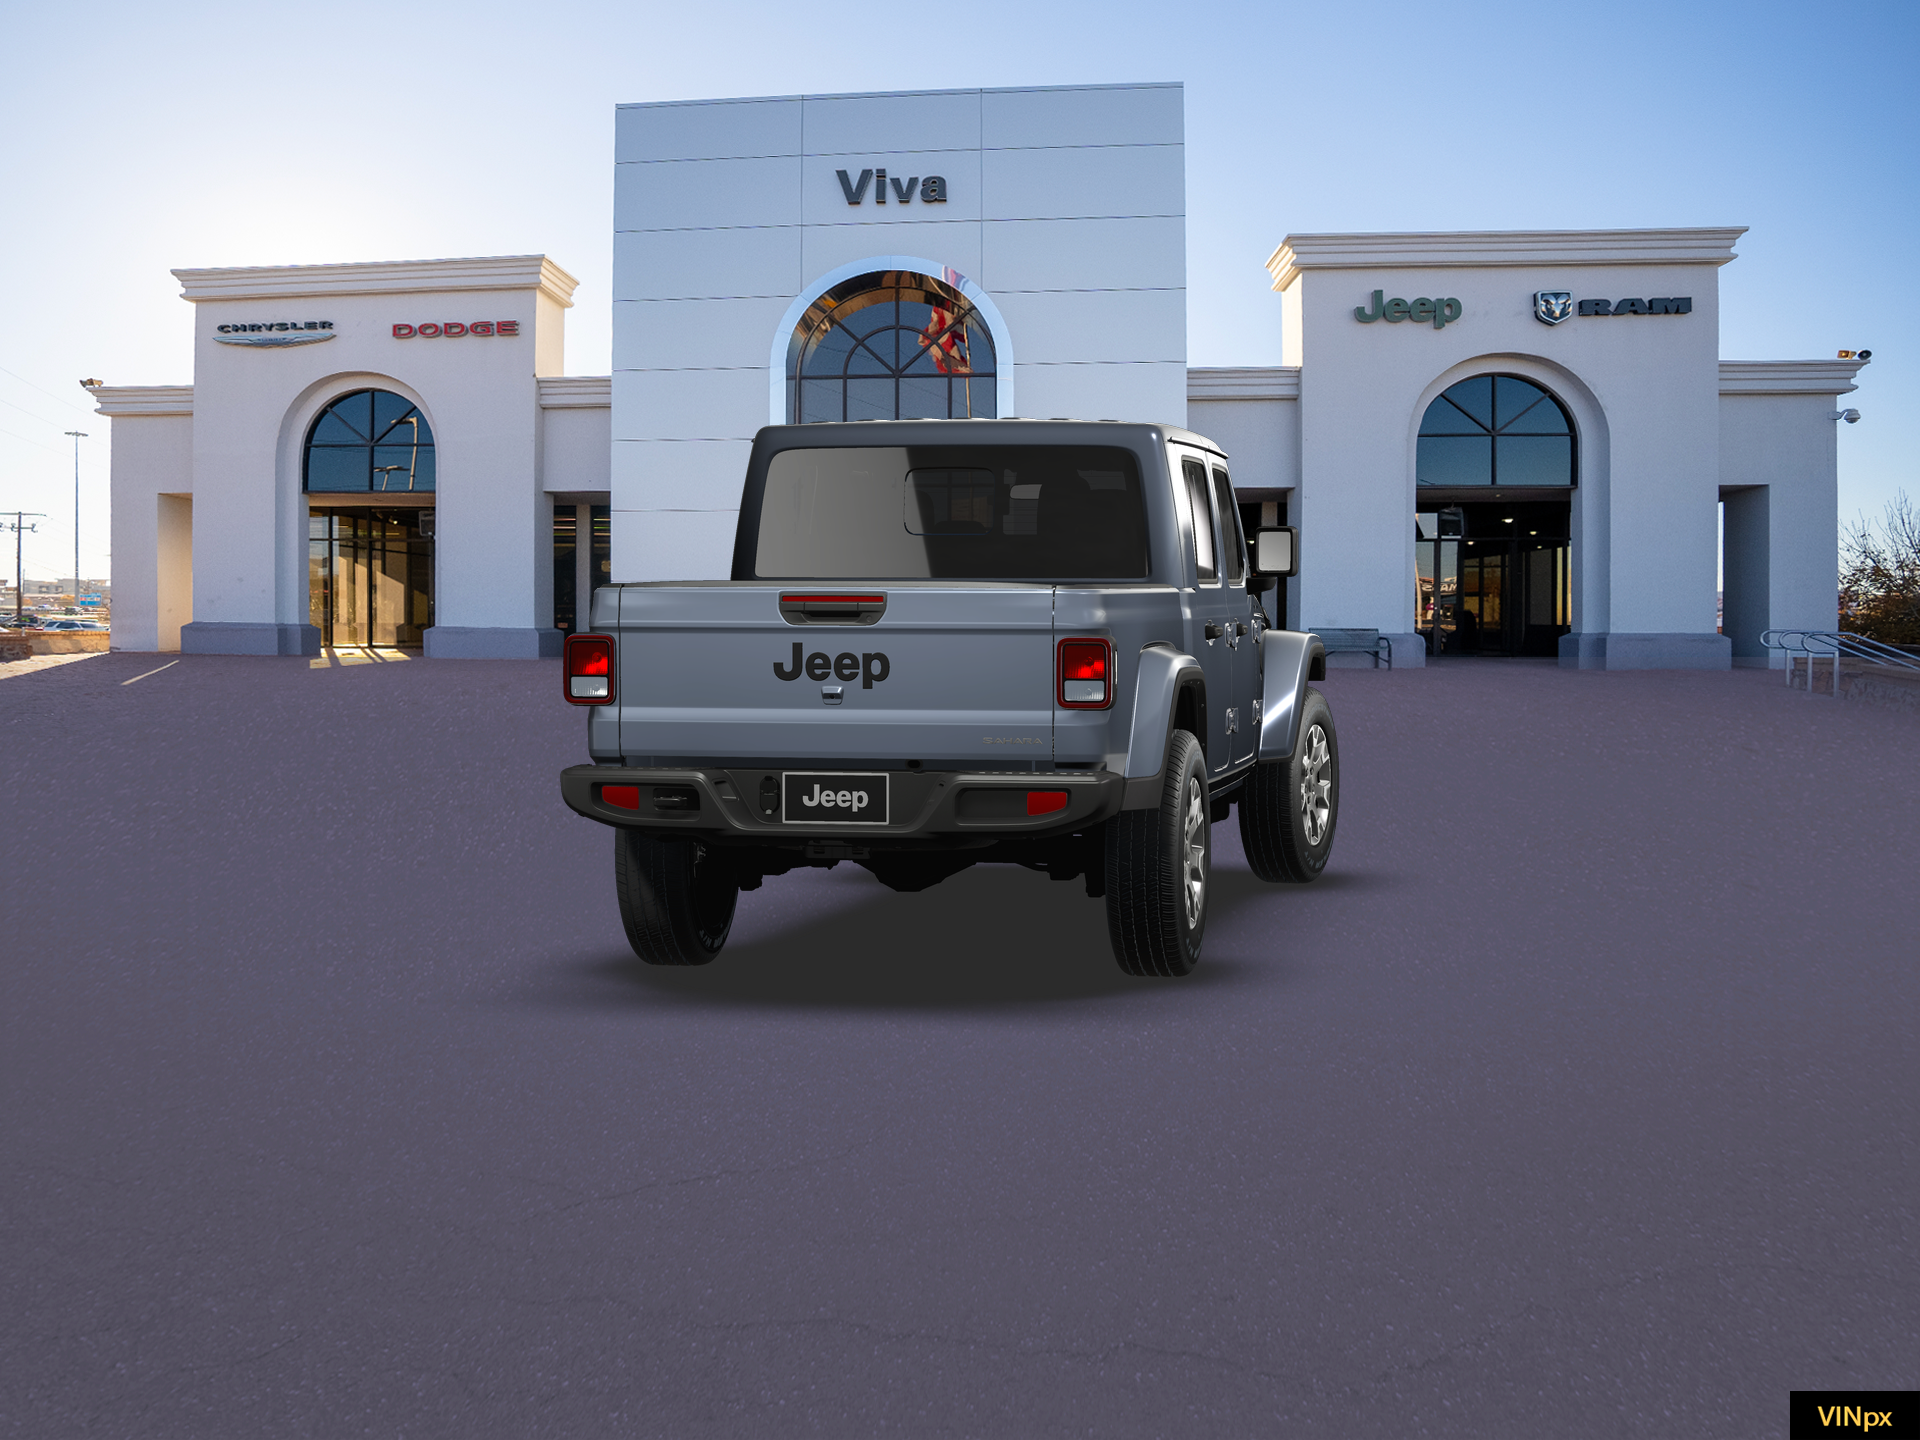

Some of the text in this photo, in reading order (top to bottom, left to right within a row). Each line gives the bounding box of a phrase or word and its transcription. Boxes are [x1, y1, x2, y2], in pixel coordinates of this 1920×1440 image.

[835, 168, 948, 205] Viva
[1354, 289, 1462, 329] Jeep
[1578, 297, 1692, 316] RAM
[217, 320, 334, 333] CHRYSLER
[392, 319, 519, 339] DODGE
[773, 642, 890, 689] Jeep
[982, 737, 1043, 745] SAHARA
[802, 784, 869, 812] Jeep
